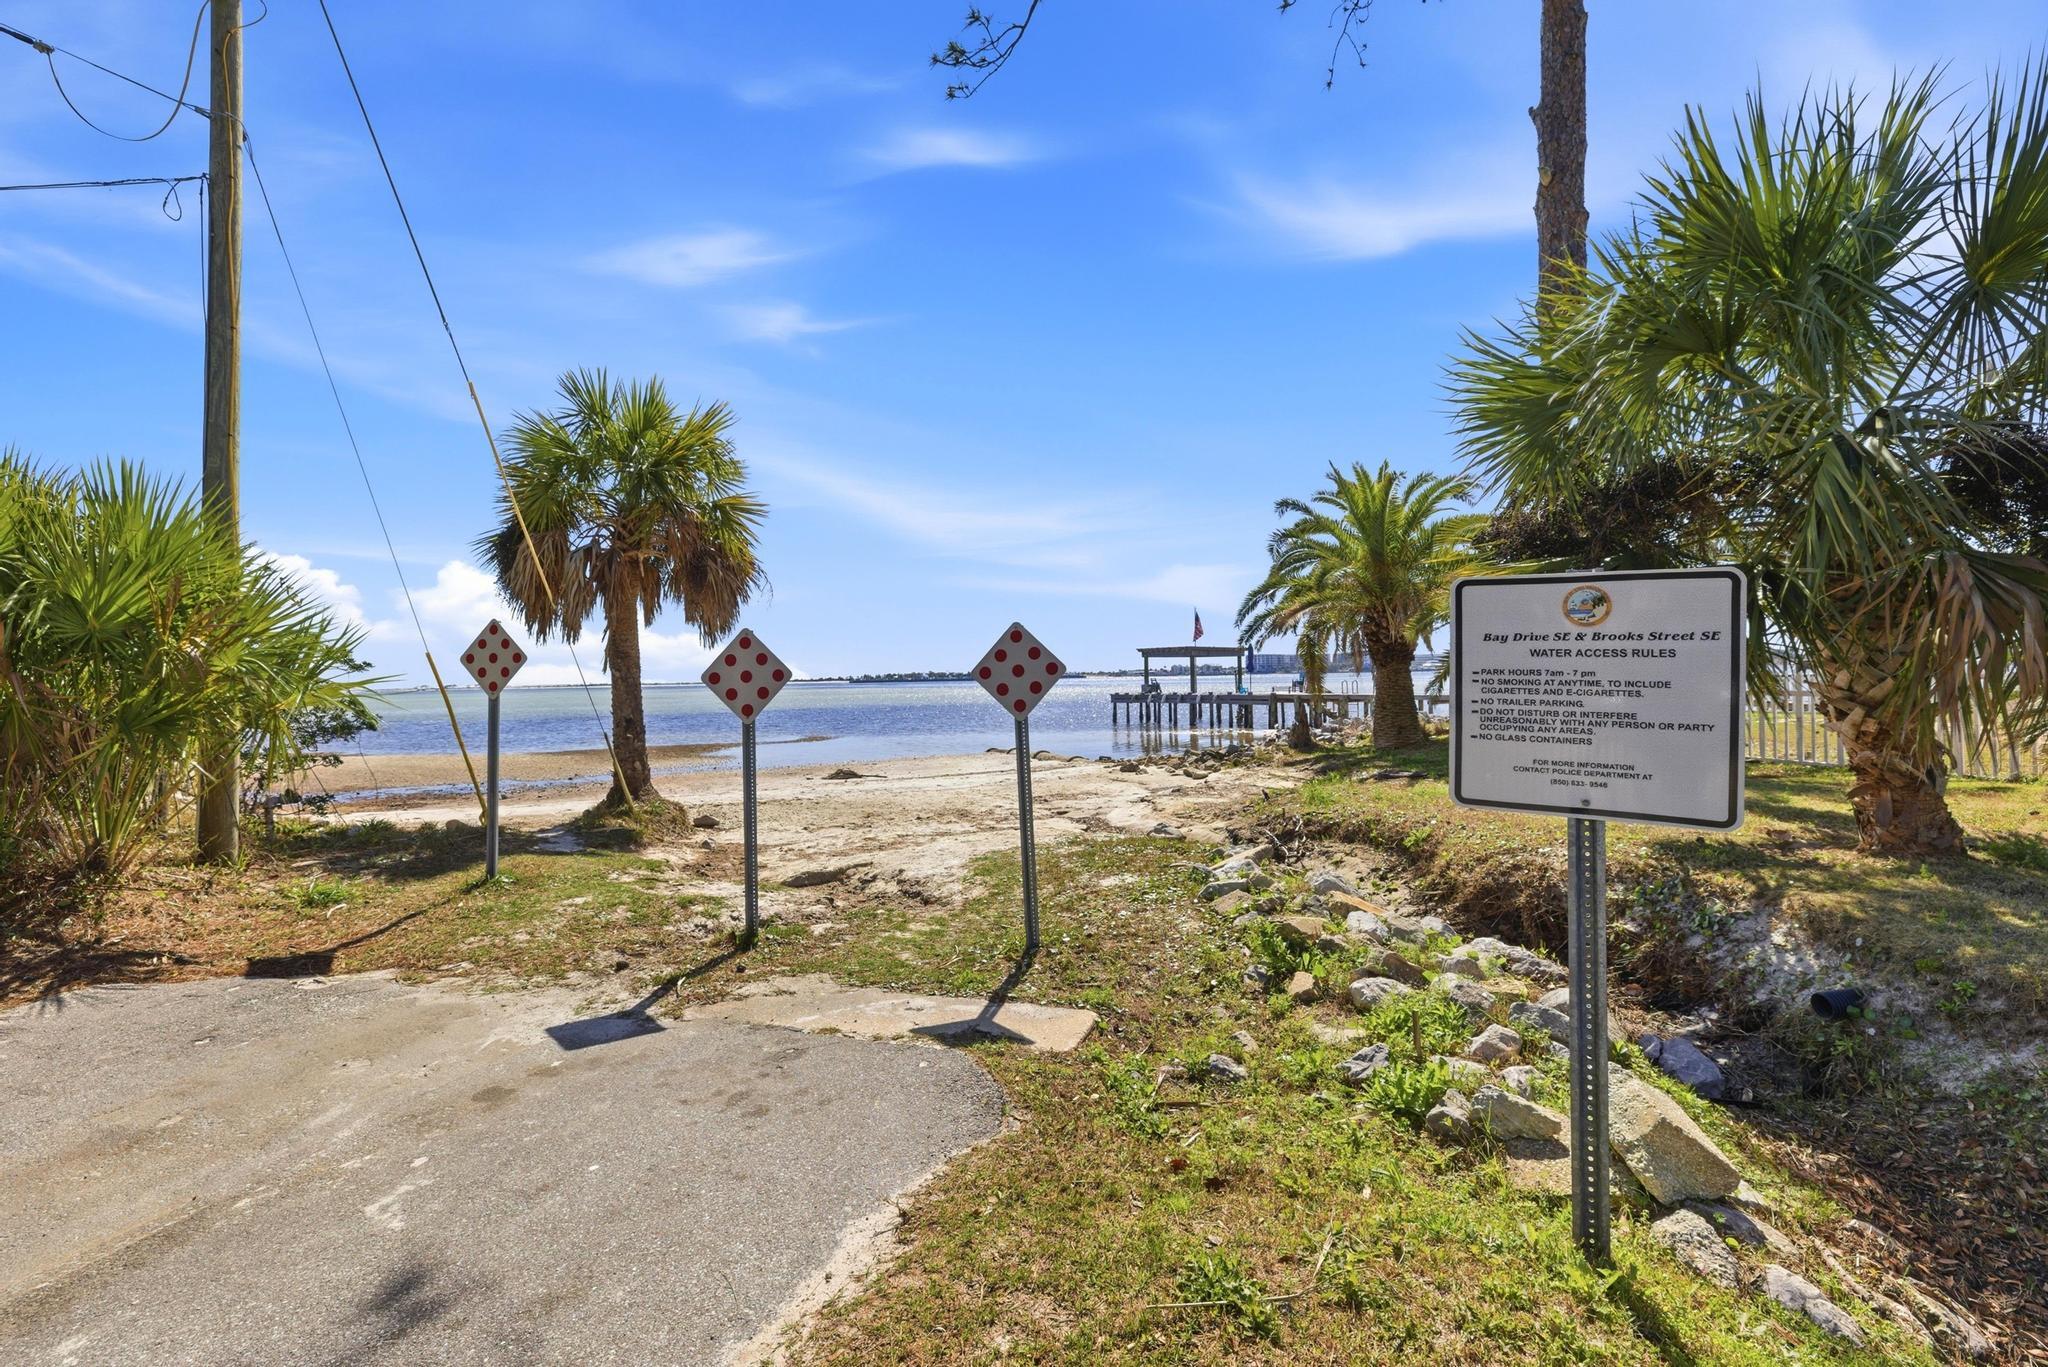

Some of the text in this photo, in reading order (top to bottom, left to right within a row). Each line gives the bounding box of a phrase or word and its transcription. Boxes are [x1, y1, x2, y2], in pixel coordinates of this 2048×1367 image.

[1483, 631, 1721, 644] Bay Drive SE & Brooks Street SE
[1529, 648, 1677, 658] WATER ACCESS RULES
[1481, 668, 1506, 676] PARK
[1544, 669, 1564, 677] 7am
[1480, 678, 1495, 686] NO
[1608, 680, 1622, 688] TO
[1624, 680, 1672, 689] INCLUDE
[1481, 687, 1540, 695] CIGARETTES
[1542, 688, 1563, 696] AND
[1497, 698, 1537, 706] TRAILER
[1539, 700, 1584, 708] PARKING.
[1495, 708, 1515, 716] NOT
[1517, 709, 1560, 717] DISTURB
[1562, 710, 1577, 718] OR
[1580, 711, 1638, 720] INTERFERE
[1479, 723, 1535, 733] OCCUPYING
[1480, 716, 1557, 725] UNREASONABLY
[1587, 719, 1609, 728] ANY
[1611, 720, 1656, 729] PERSON
[1658, 722, 1675, 730] OR
[1677, 723, 1715, 732] PARTY
[1479, 733, 1593, 745] NO GLASS CONTAINERS
[1551, 760, 1575, 768] MORE
[1576, 761, 1635, 771] INFORMATION
[1512, 765, 1550, 774] CONTACT
[1552, 768, 1581, 776] POLICE
[1583, 770, 1641, 780] DEPARTMENT
